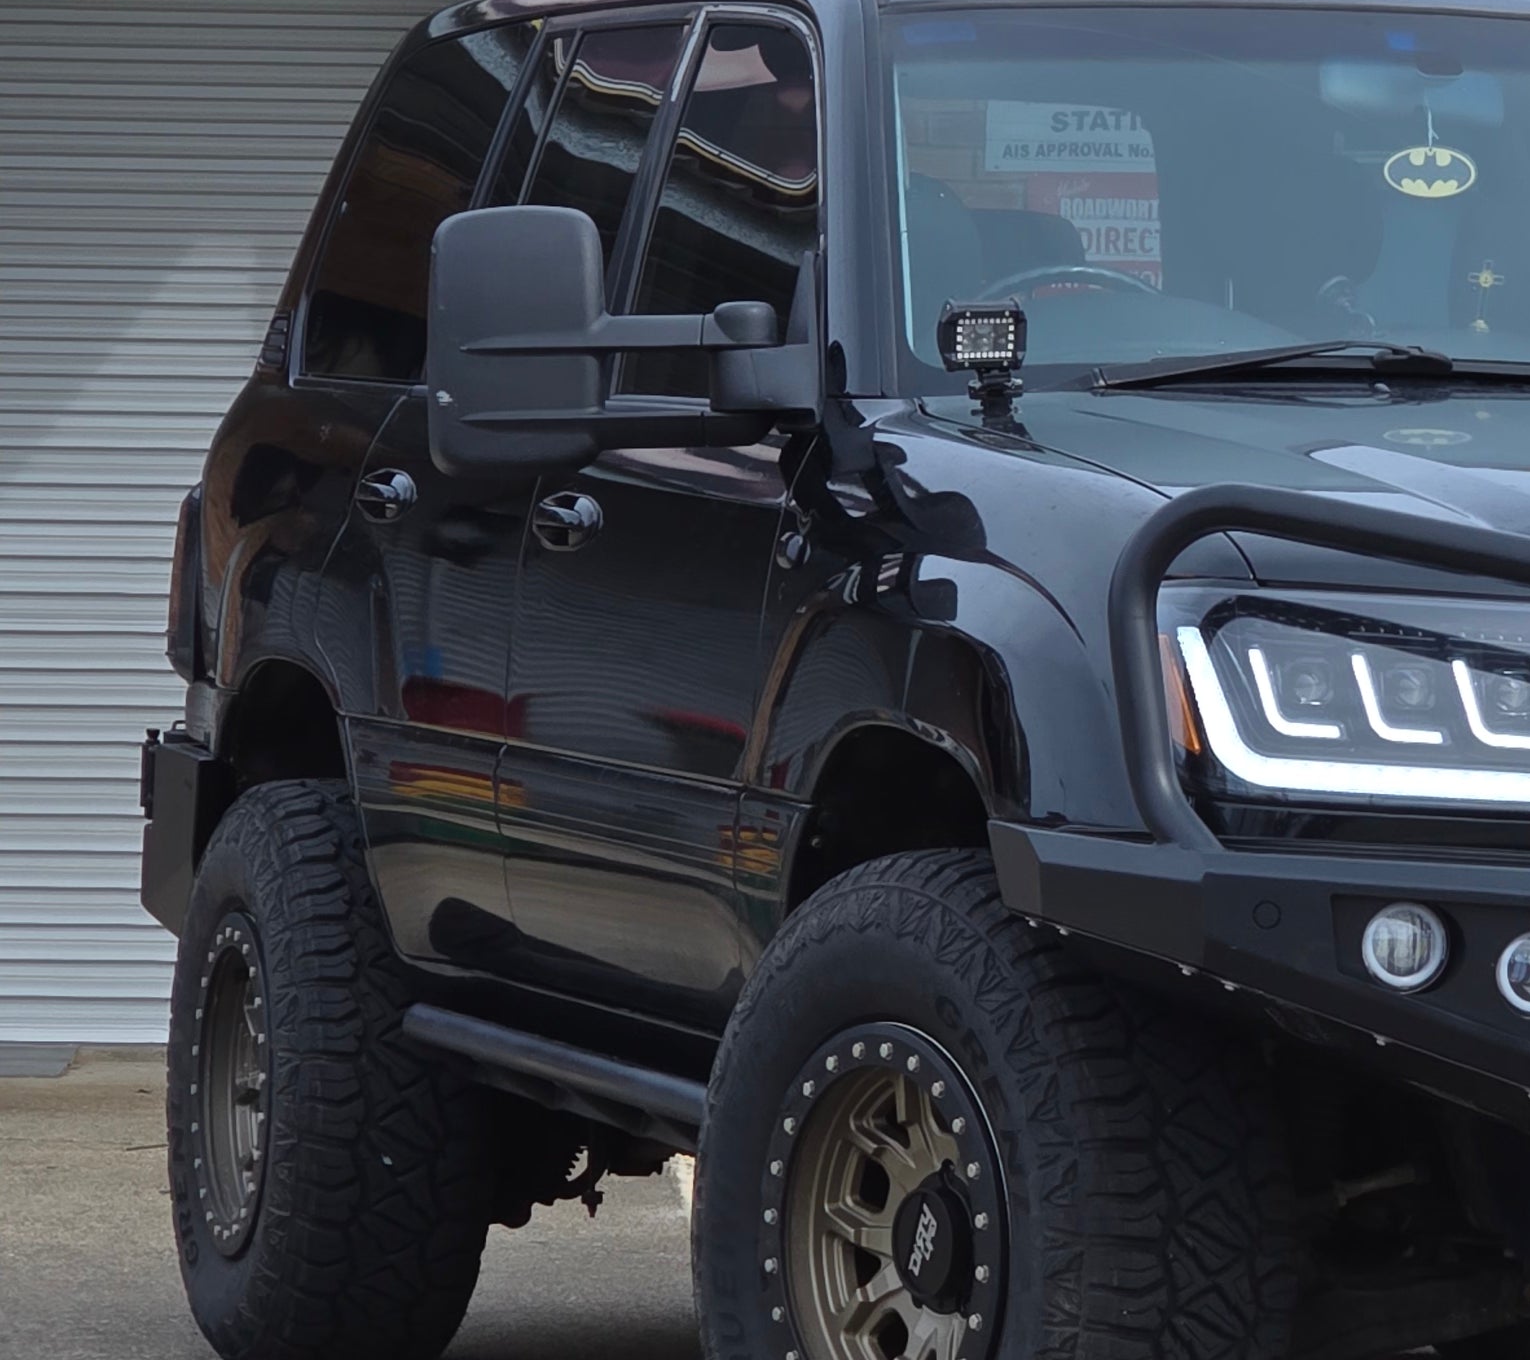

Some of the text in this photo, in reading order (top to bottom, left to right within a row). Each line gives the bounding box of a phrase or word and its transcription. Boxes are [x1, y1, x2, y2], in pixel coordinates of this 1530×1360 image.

[1002, 143, 1031, 159] AIS
[1035, 141, 1123, 159] APPROVAL
[1078, 226, 1160, 255] DIREC
